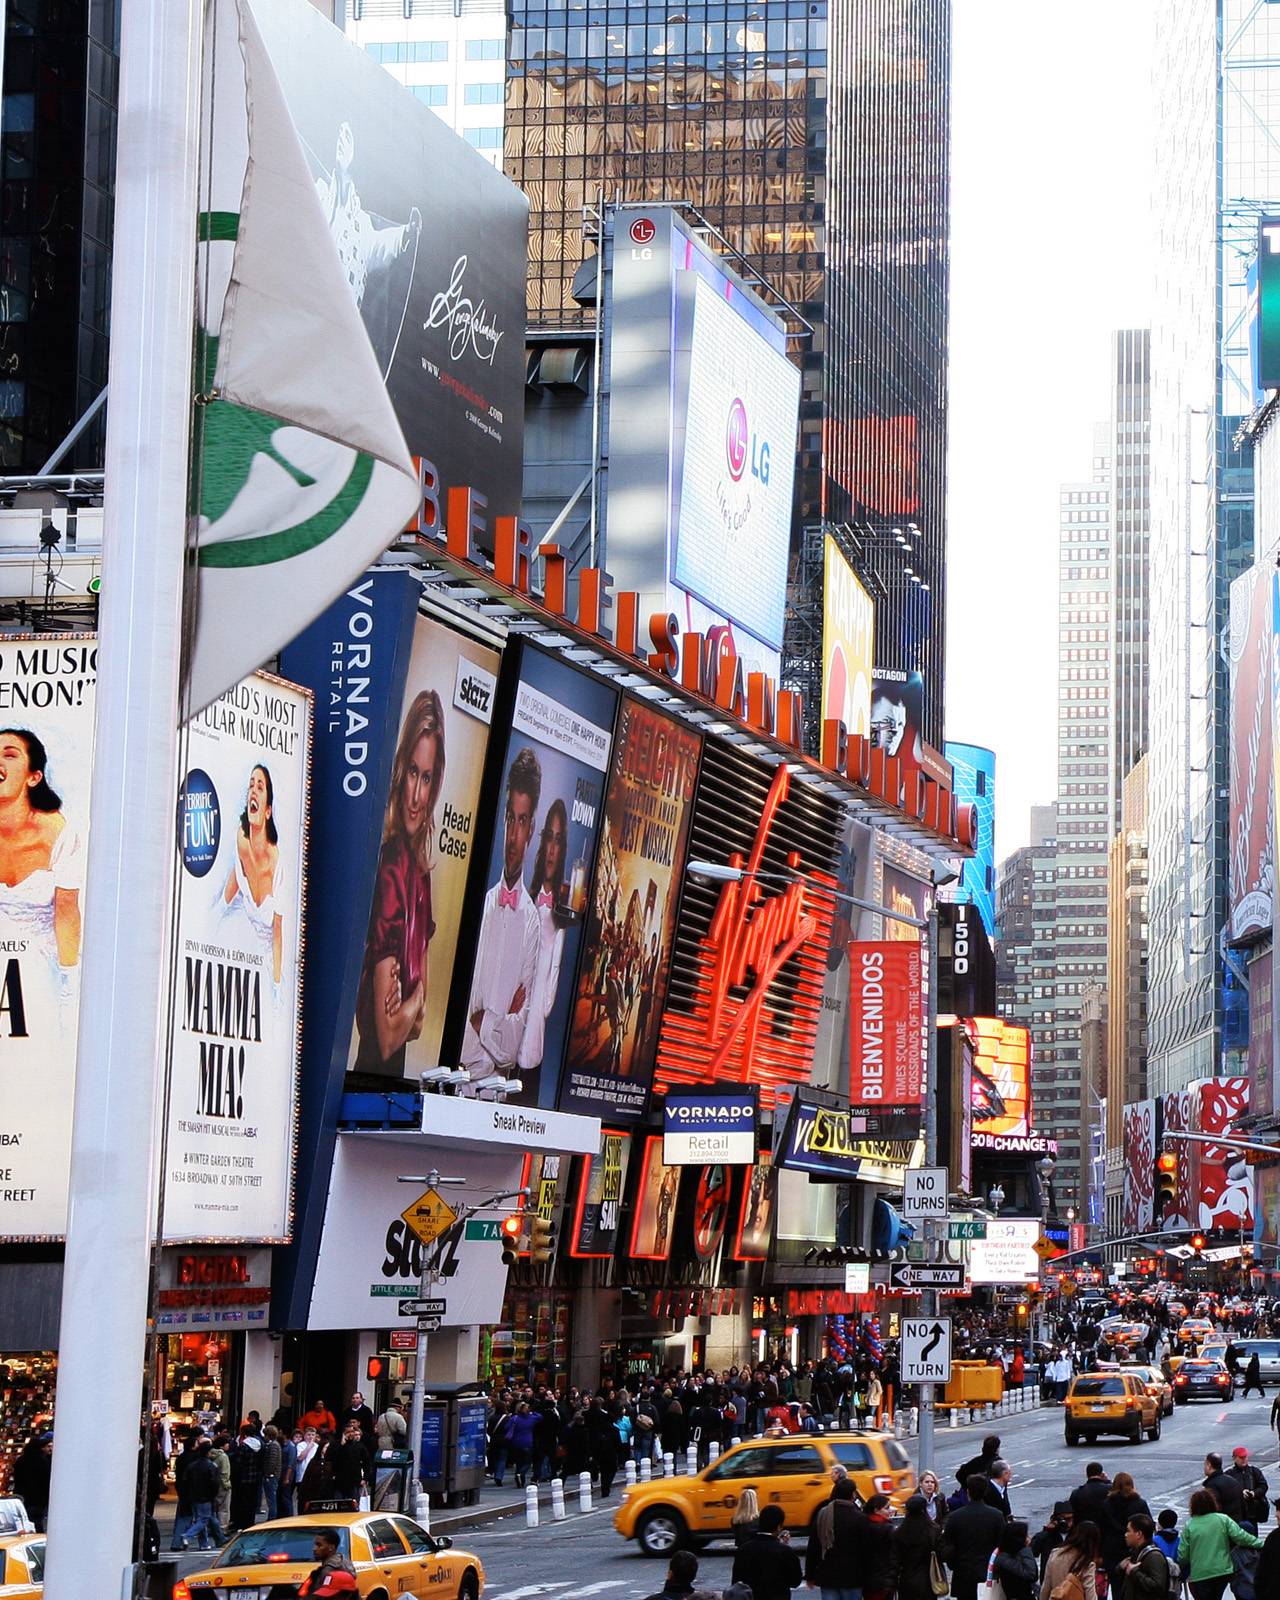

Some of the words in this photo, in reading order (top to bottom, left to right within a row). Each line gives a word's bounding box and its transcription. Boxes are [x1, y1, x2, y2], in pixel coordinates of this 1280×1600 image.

[632, 248, 652, 261] LG
[751, 434, 770, 486] LG
[872, 669, 907, 682] OCTAGON
[328, 642, 342, 733] RETAIL
[347, 579, 374, 797] VORNADO
[264, 696, 296, 727] MOST
[443, 803, 471, 834] Head
[571, 800, 595, 828] DOWN
[439, 830, 467, 861] Case
[954, 905, 969, 975] 1500
[909, 951, 919, 988] WORLD
[182, 957, 262, 1042] MAMMA
[909, 990, 919, 1010] THE
[862, 952, 884, 1099] BIENVENIDOS
[909, 1015, 919, 1028] OF
[896, 1021, 907, 1060] SQUARE
[909, 1029, 919, 1097] CROSSROADS
[197, 1041, 246, 1120] MIA!
[896, 1066, 907, 1098] TIMES
[494, 1111, 516, 1130] Sneak
[518, 1115, 547, 1135] Preview
[666, 1106, 753, 1119] VORNADO
[689, 1136, 728, 1149] Retail
[994, 1138, 1046, 1151] CHANGE
[189, 1153, 209, 1166] WINTER
[211, 1154, 231, 1167] GARDEN
[233, 1156, 255, 1168] THEATRE
[171, 1172, 186, 1182] 1634
[187, 1173, 219, 1184] BROADWAY
[220, 1175, 227, 1185] AT
[244, 1175, 262, 1187] STREET
[916, 1177, 935, 1190] NO
[907, 1196, 945, 1210] TURNS
[483, 1224, 489, 1237] 7
[951, 1225, 959, 1237] W
[962, 1225, 974, 1238] 46
[977, 1224, 985, 1232] ST
[902, 1271, 922, 1280] ONE
[932, 1271, 955, 1280] WAY
[906, 1325, 928, 1337] NO
[908, 1365, 944, 1375] TURN
